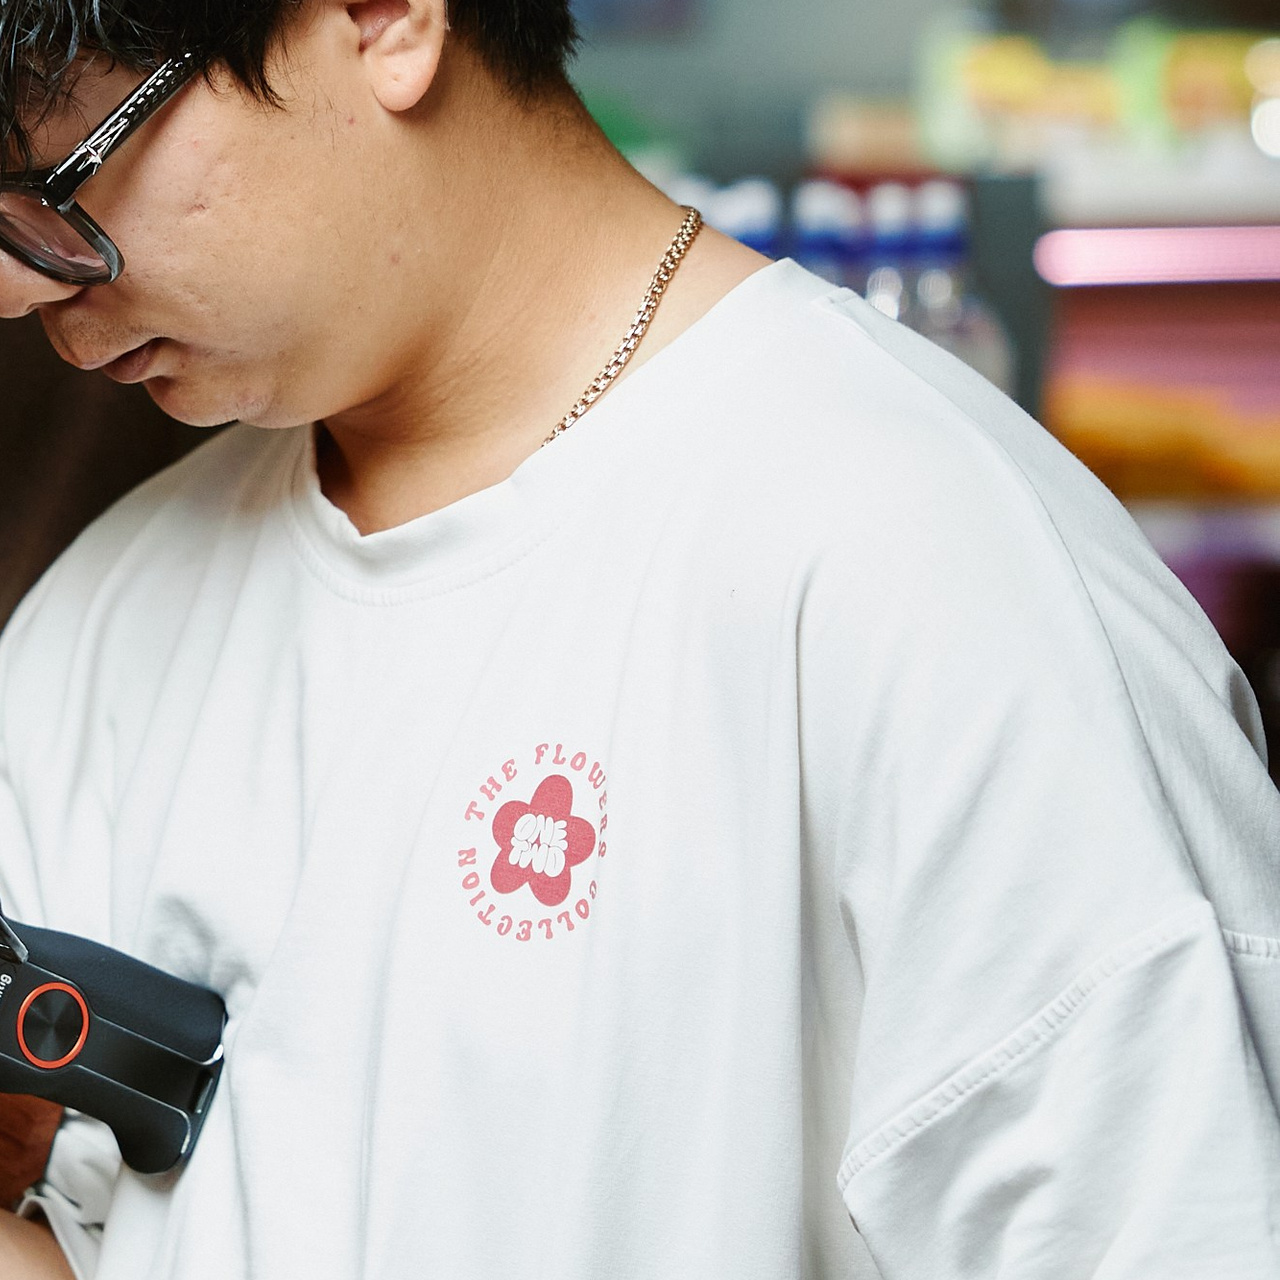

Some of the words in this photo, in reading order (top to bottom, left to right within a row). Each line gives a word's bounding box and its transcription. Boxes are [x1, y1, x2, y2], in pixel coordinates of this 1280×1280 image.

[464, 758, 517, 821] THE
[534, 743, 608, 858] FLOWERS
[508, 836, 566, 878] TWO
[513, 813, 568, 851] ONE
[457, 847, 598, 942] COLLECTION
